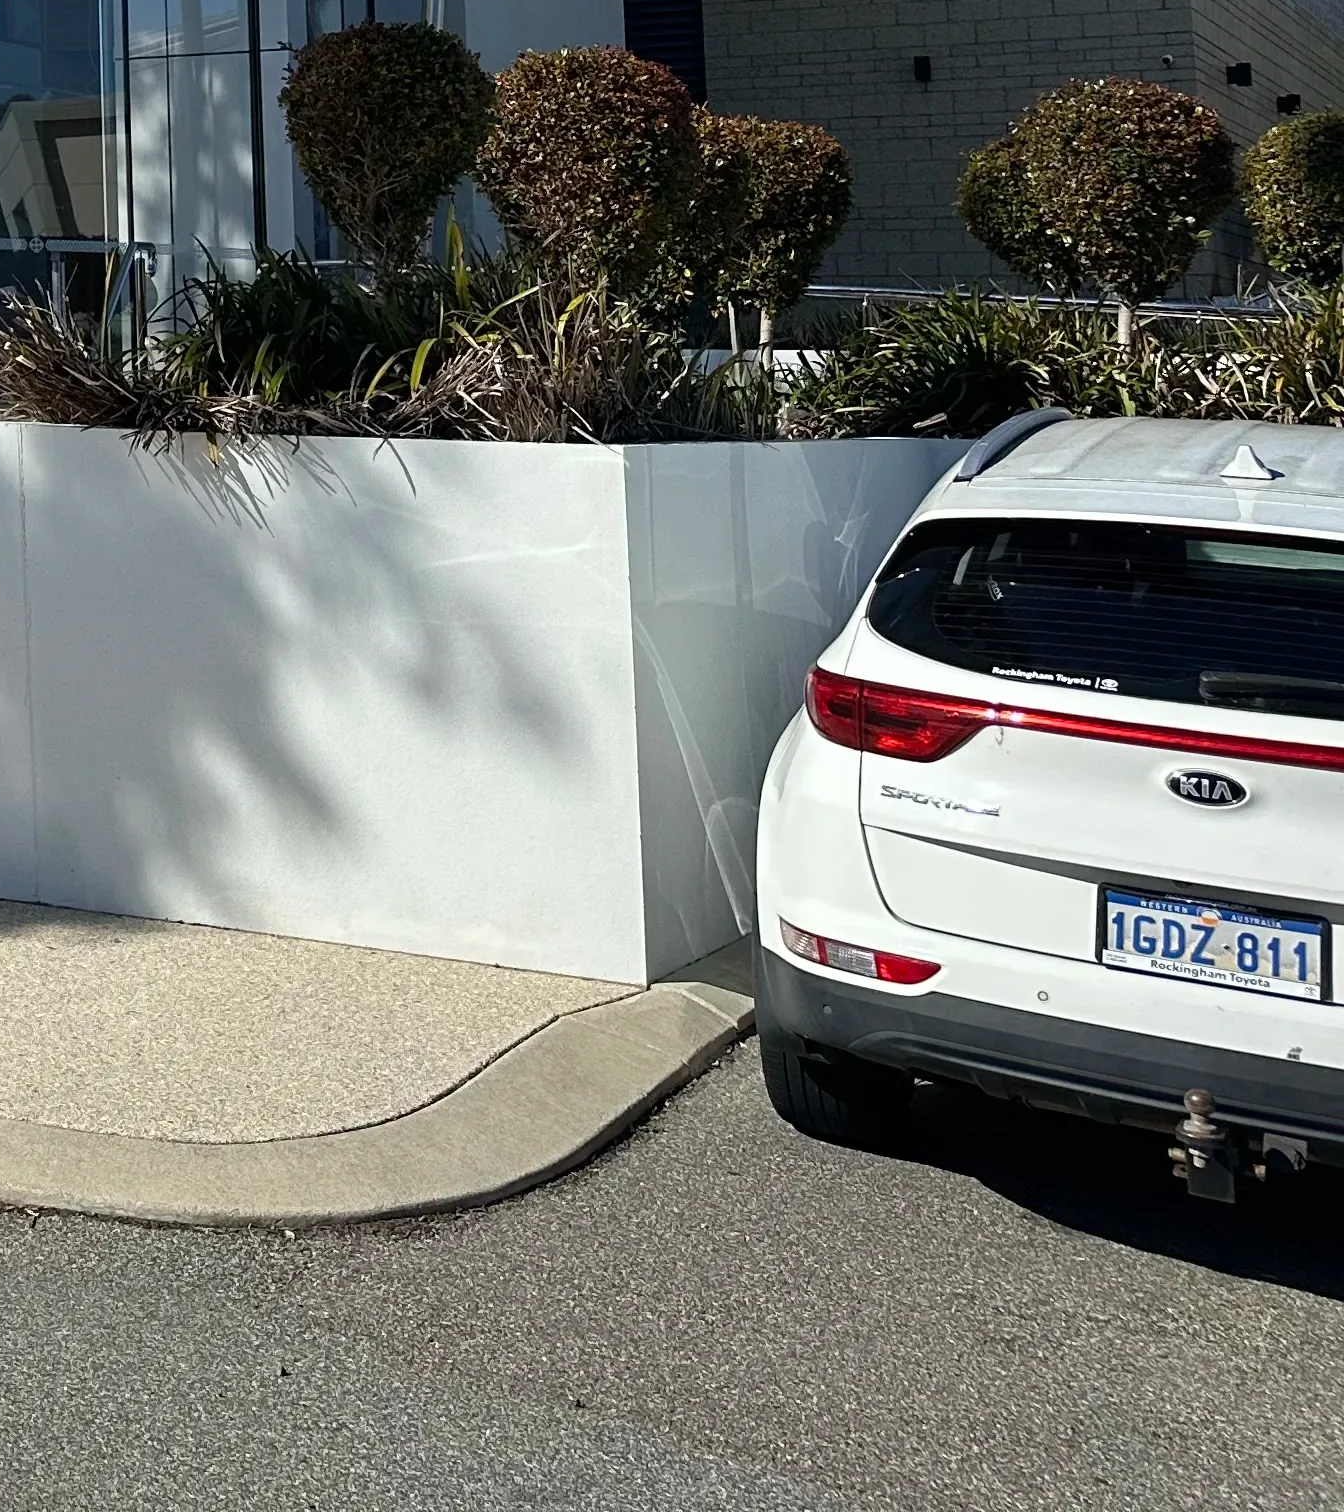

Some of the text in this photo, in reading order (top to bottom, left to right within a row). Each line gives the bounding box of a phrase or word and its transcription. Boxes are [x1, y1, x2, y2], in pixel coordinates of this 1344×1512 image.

[992, 666, 1092, 685] Rockingham Toyota
[880, 784, 1001, 817] SPORTAE
[1179, 775, 1233, 801] KIA
[1140, 900, 1188, 914] WESTERN
[1230, 914, 1282, 929] AUSTRALIA
[1112, 911, 1307, 982] 1GDZ 811
[1150, 959, 1271, 989] Rockingham Toyota
